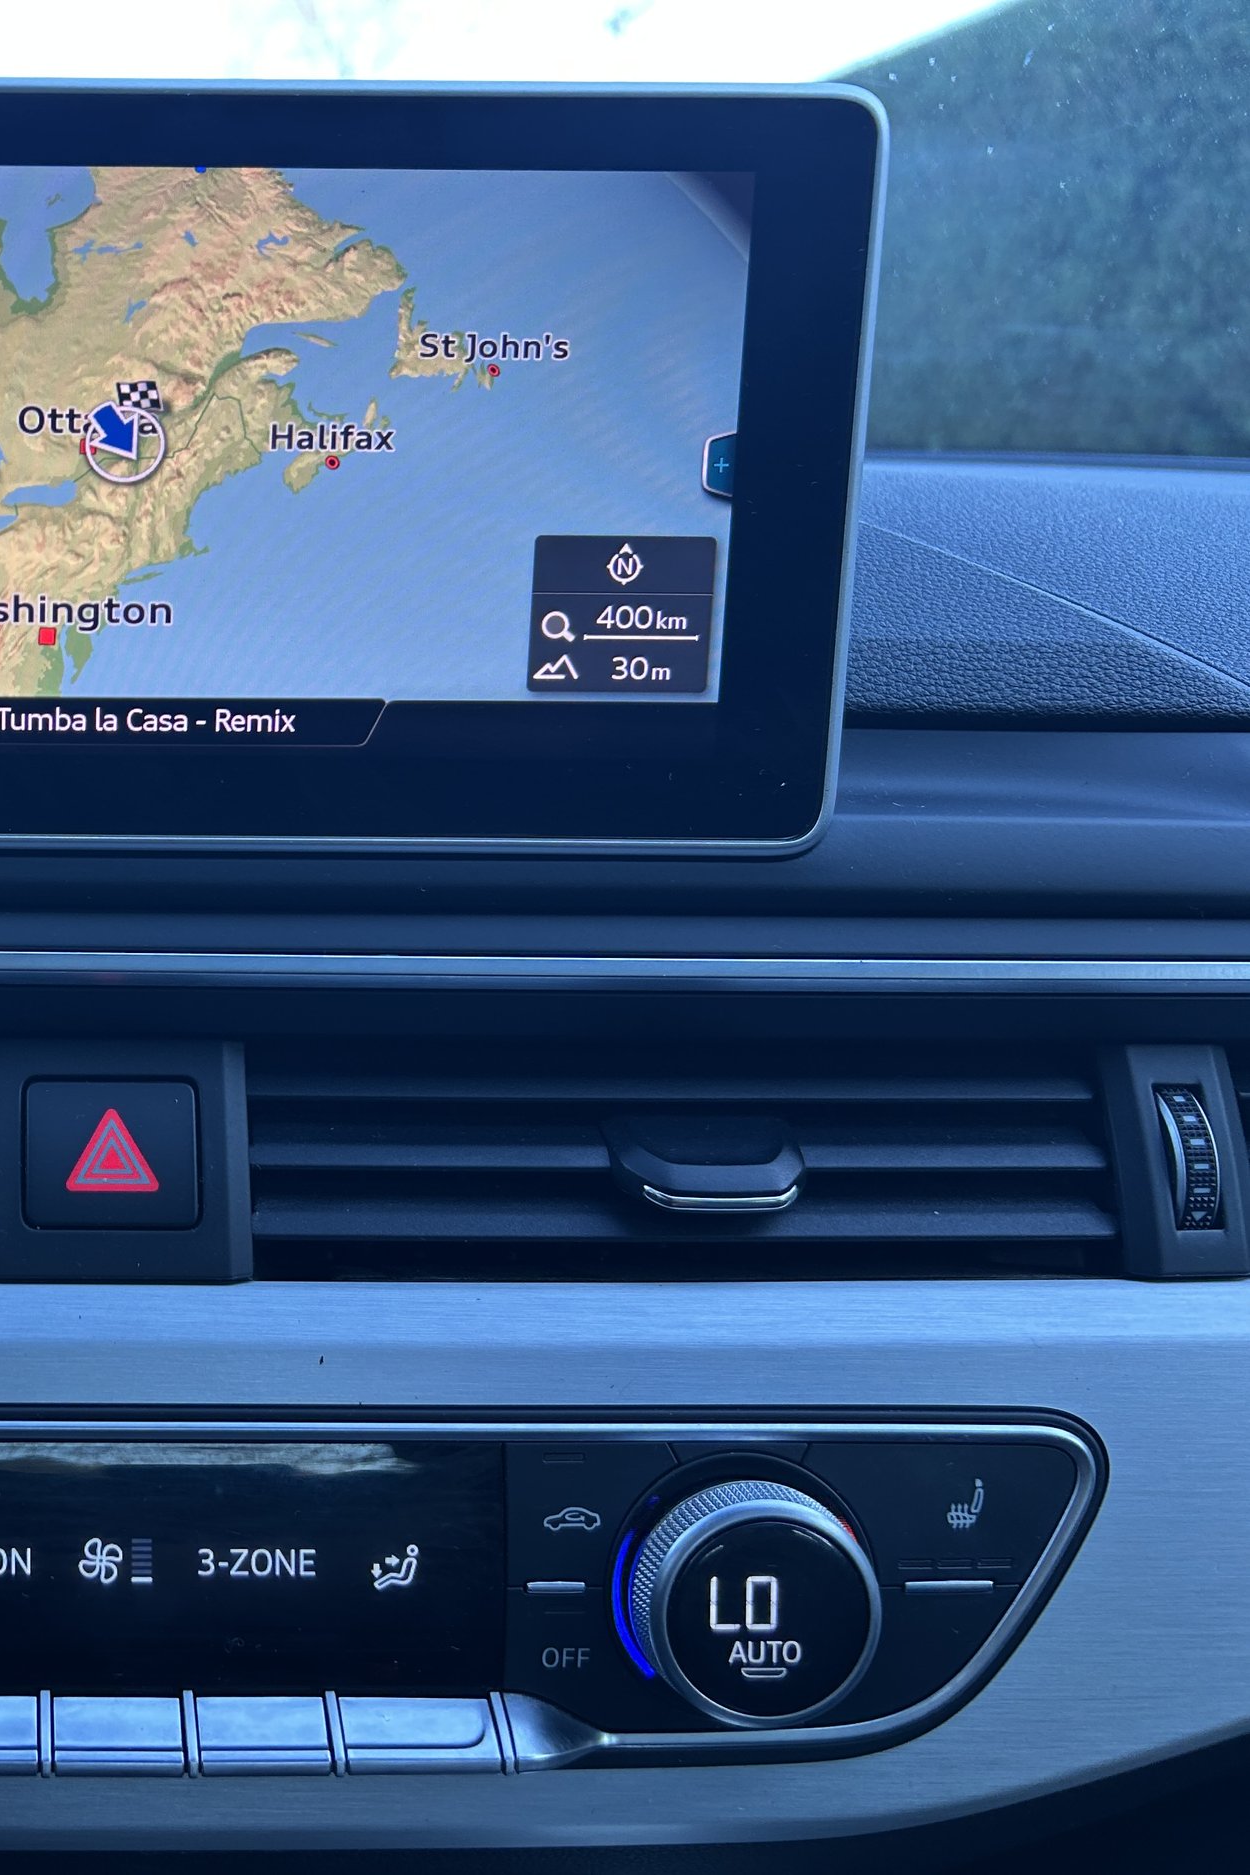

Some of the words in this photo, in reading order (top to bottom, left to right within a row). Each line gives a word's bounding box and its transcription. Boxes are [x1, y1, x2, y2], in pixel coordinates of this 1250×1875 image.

[420, 333, 456, 358] St
[464, 333, 569, 363] John's
[18, 405, 158, 435] Otta
[270, 424, 395, 451] Halifax
[95, 706, 118, 732] la
[126, 708, 189, 733] Casa
[215, 708, 297, 733] Remix
[197, 1548, 316, 1577] 3-ZONE
[709, 1574, 779, 1632] LO
[541, 1647, 591, 1669] OFF
[727, 1640, 802, 1664] AUTO
